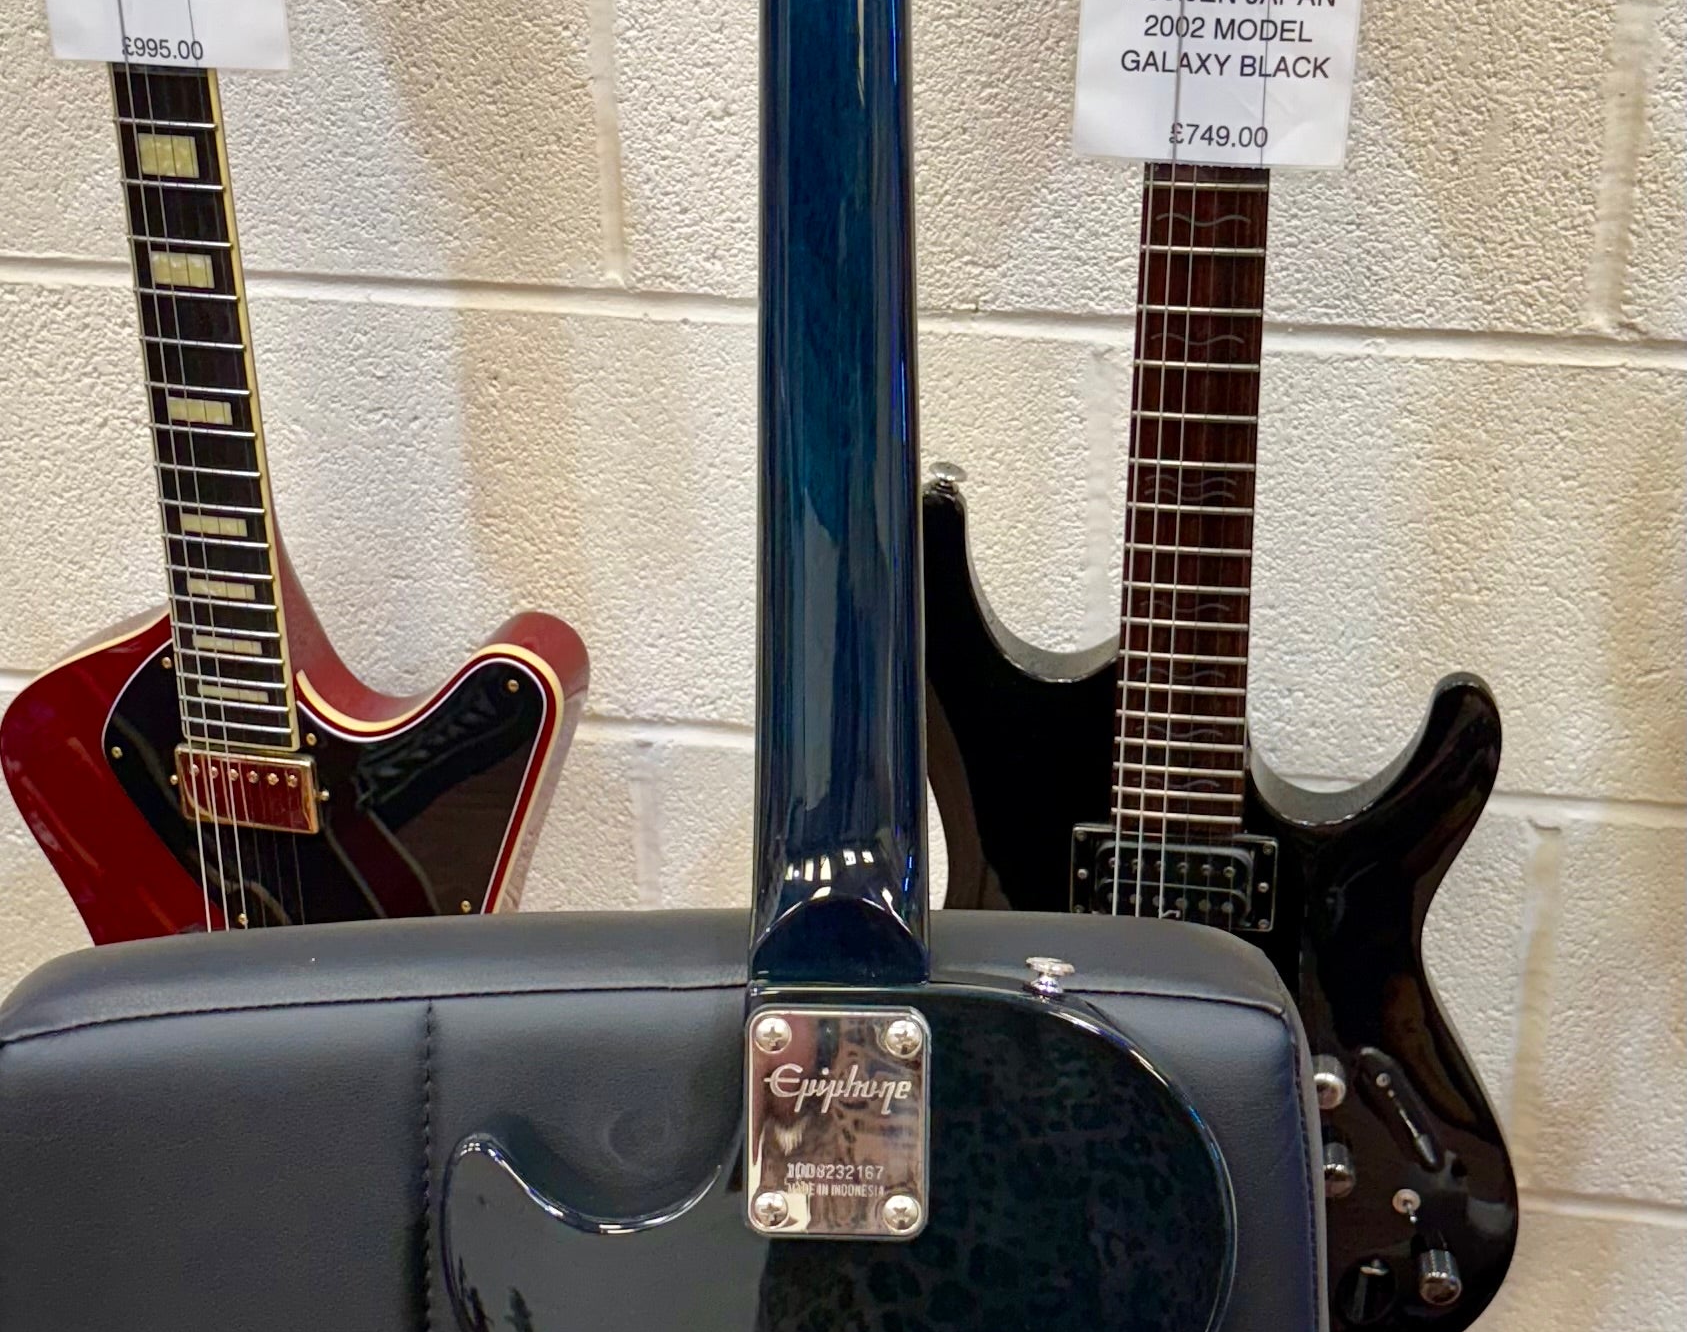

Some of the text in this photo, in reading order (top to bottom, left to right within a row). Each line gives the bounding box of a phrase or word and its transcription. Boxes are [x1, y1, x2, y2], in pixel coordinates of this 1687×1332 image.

[1144, 15, 1312, 43] 2002 MODEL
[122, 36, 204, 60] £995.00
[1121, 50, 1331, 79] GALAXY BLACK
[1169, 123, 1269, 149] £749.00
[763, 1063, 912, 1115] Epiphone
[787, 1181, 885, 1197] MADE IN INDONESIA
